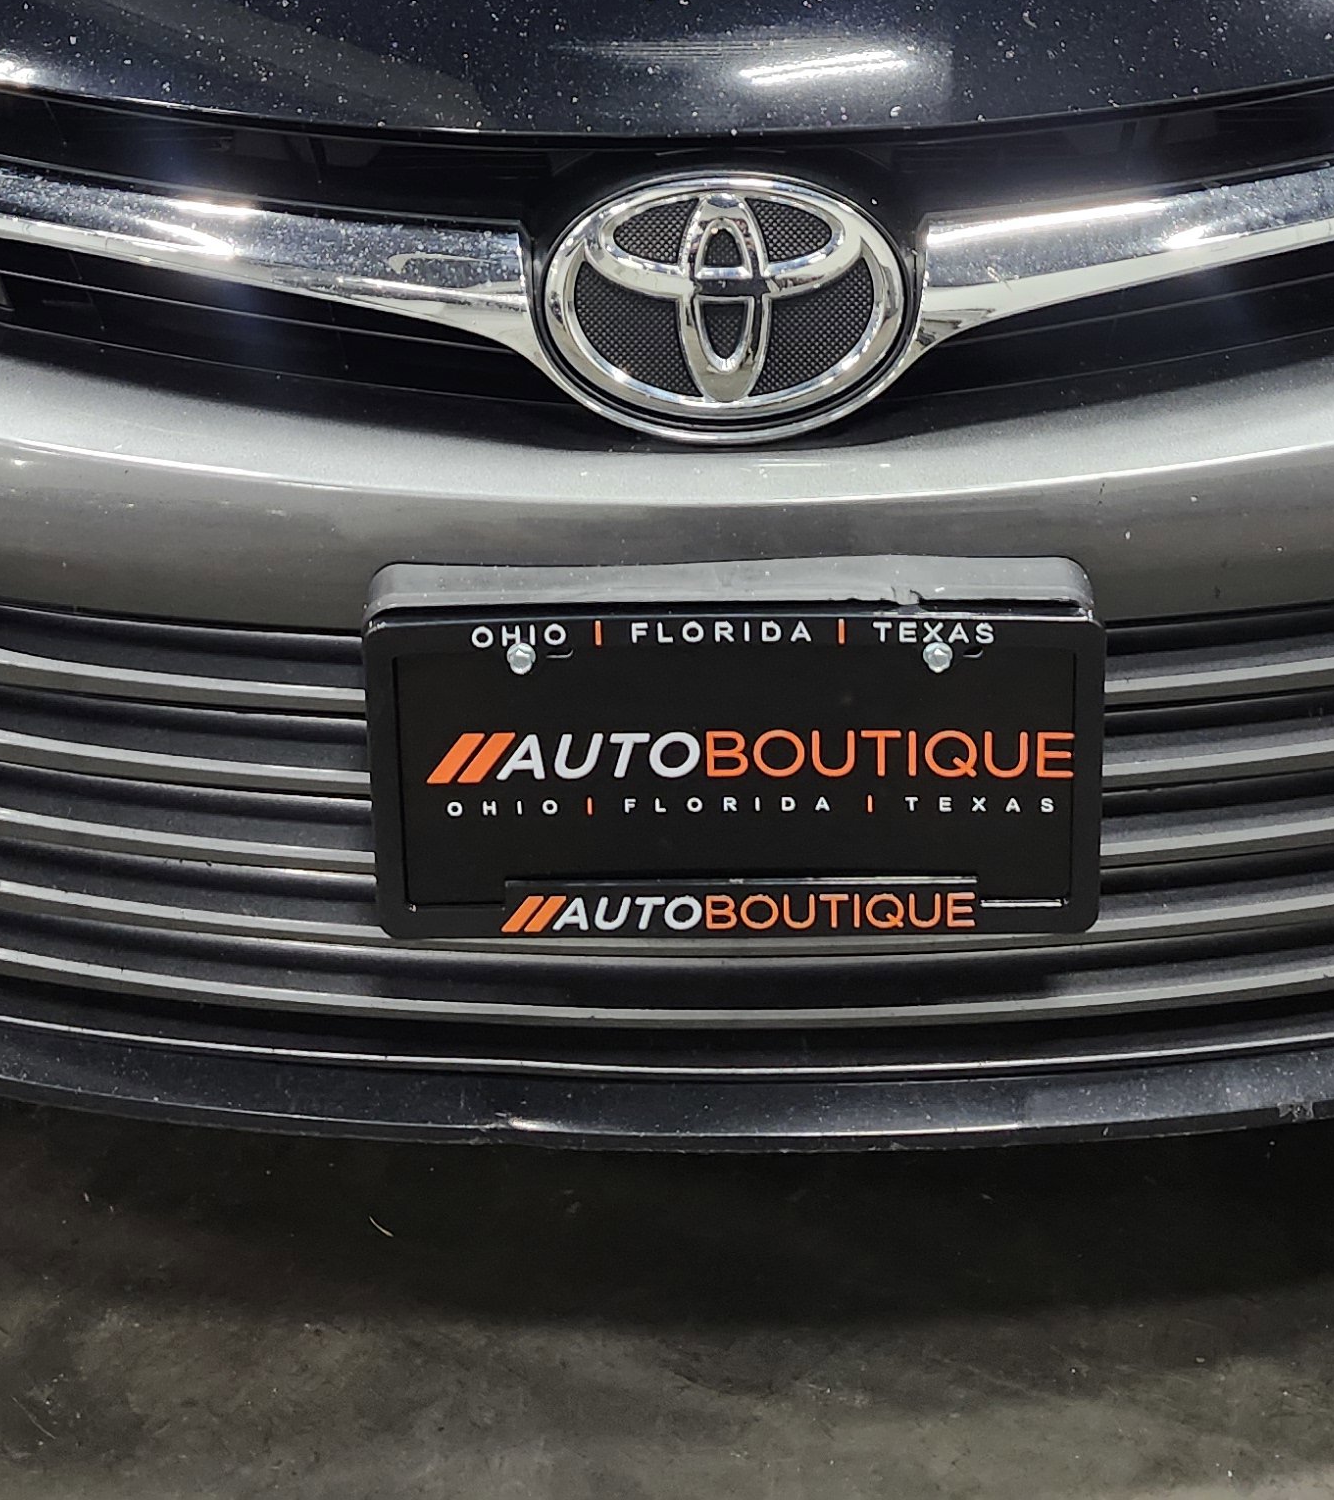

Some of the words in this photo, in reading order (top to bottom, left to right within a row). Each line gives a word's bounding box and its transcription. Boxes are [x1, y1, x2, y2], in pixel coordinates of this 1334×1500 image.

[471, 623, 566, 648] OHIO
[631, 620, 812, 644] FLORIDA
[872, 621, 995, 644] TEXAS
[497, 729, 1075, 781] AUTOBOUTIQUE
[446, 799, 558, 817] OHIO
[624, 796, 830, 814] FLORIDA
[904, 796, 1054, 813] TEXAS
[552, 891, 976, 932] AUTOBOUTIQUE
